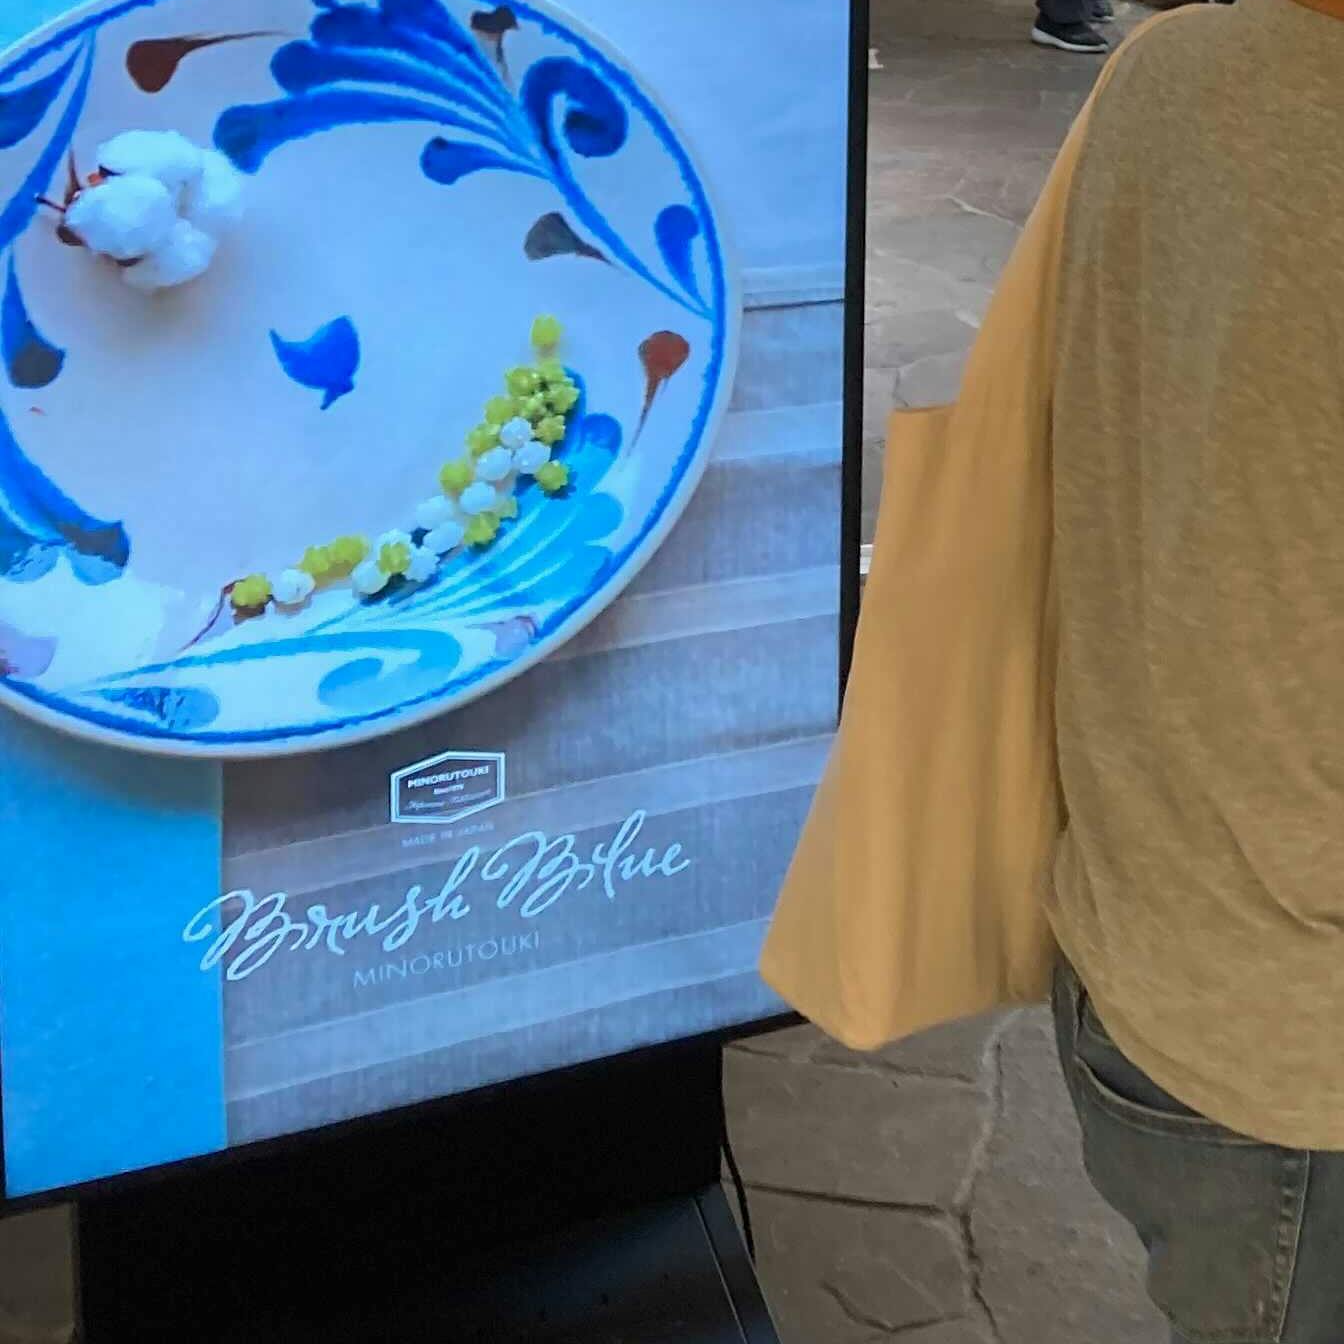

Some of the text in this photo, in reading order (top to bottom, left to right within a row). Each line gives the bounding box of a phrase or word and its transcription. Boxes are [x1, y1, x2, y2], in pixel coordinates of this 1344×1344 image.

[407, 765, 489, 788] MINORUTOUKI
[182, 810, 691, 981] Brush Blue
[353, 932, 540, 989] MINORUTOUKI
